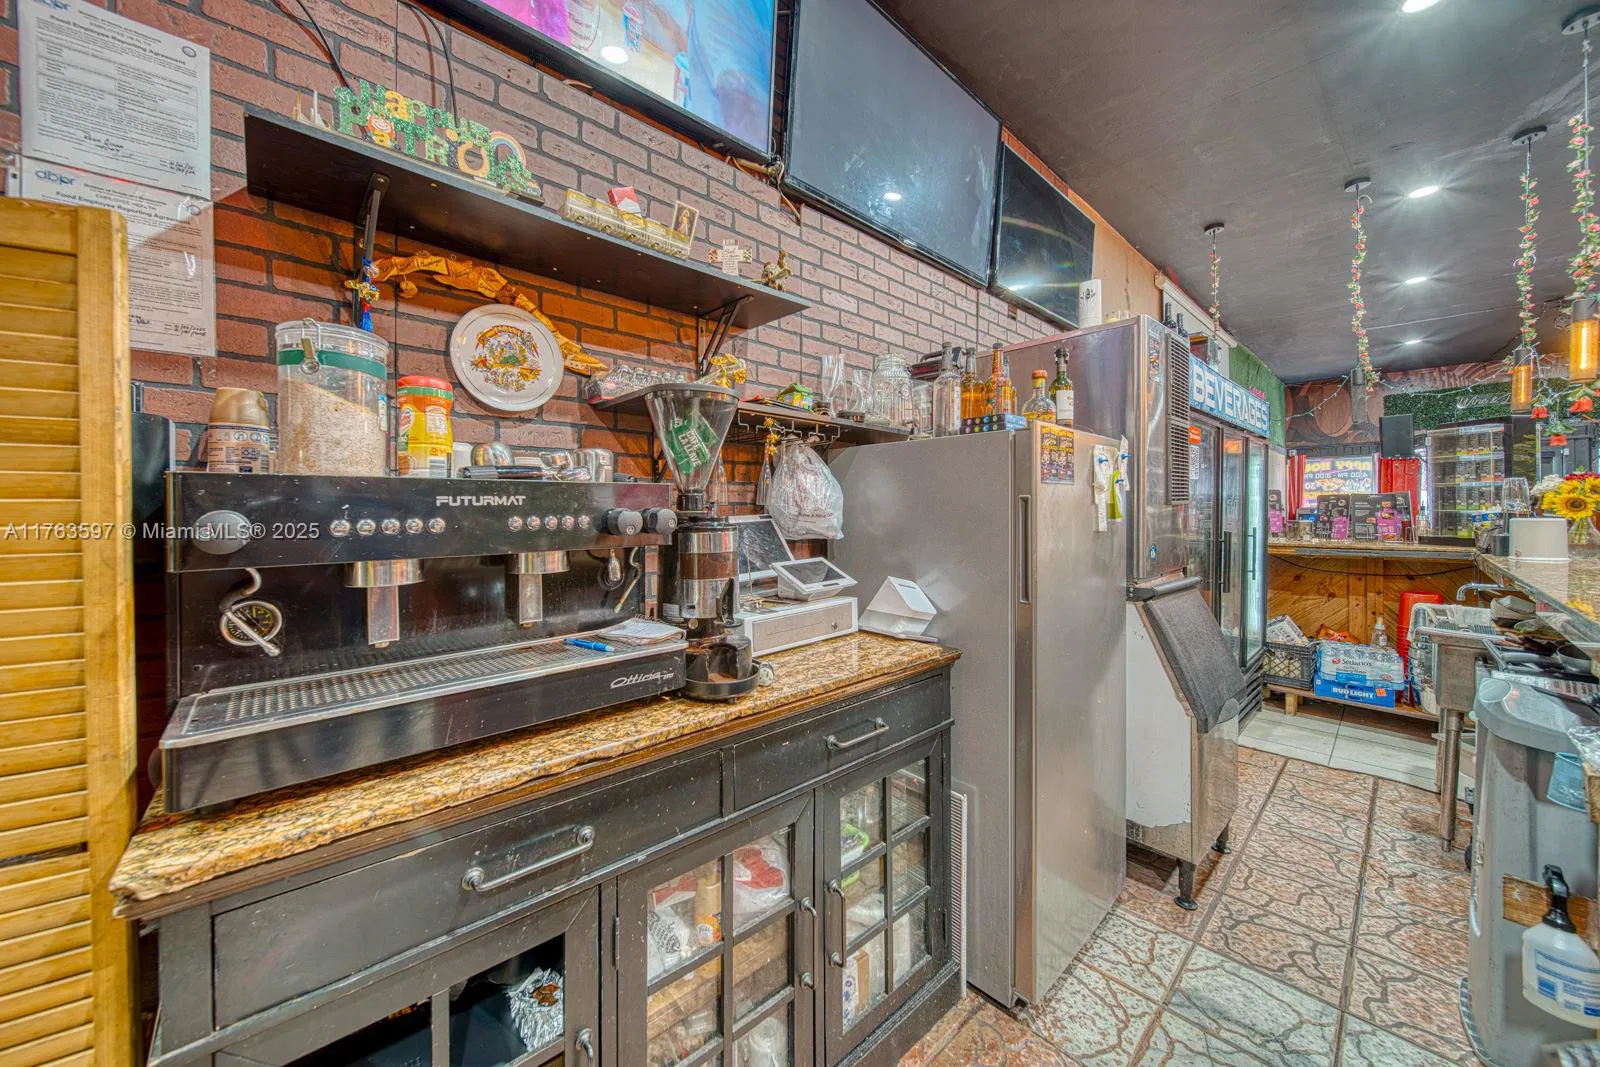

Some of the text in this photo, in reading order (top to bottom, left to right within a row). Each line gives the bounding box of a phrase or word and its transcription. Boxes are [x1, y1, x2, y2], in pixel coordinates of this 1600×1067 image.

[35, 169, 75, 186] dbpr
[56, 191, 76, 200] Food
[117, 205, 152, 218] Reporting
[96, 194, 157, 211] EMPLOYEE HEALTH
[1193, 364, 1269, 431] BEVERAGES
[436, 495, 527, 507] FUTURMAT
[1332, 687, 1374, 699] BUD LIGHT
